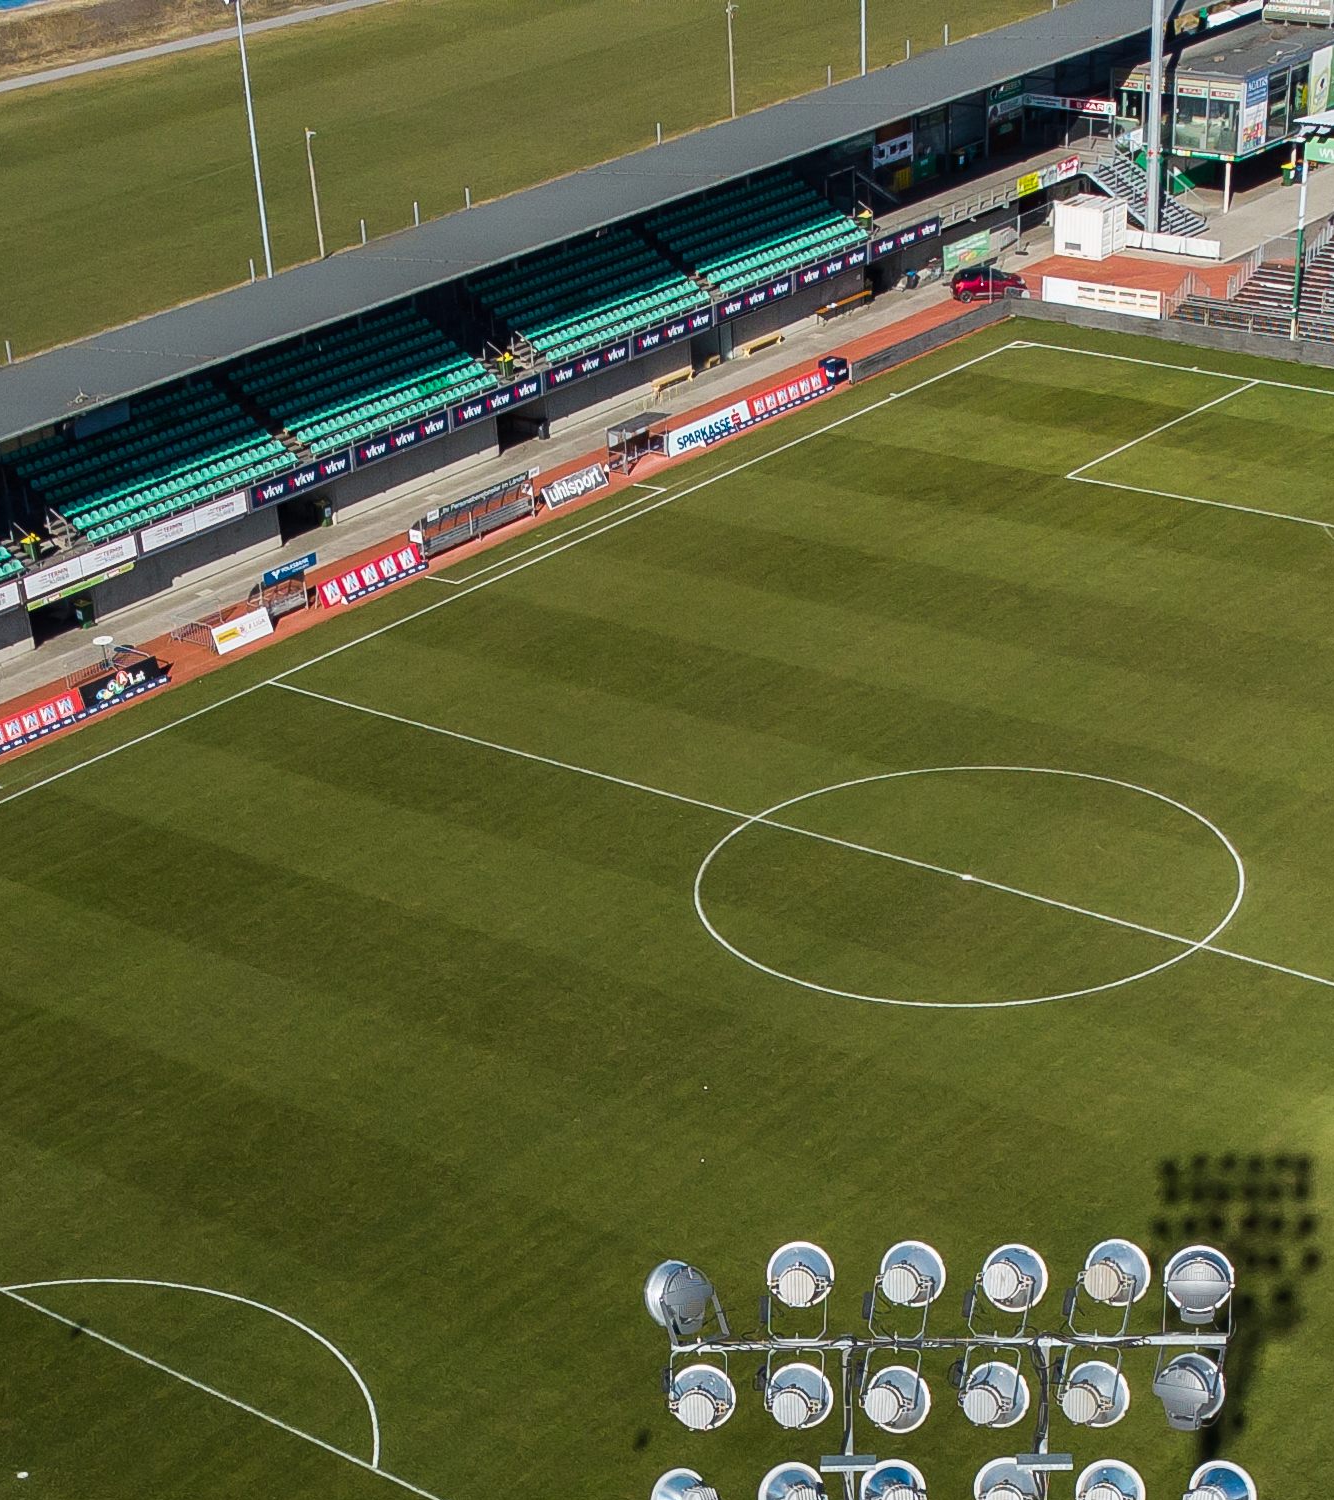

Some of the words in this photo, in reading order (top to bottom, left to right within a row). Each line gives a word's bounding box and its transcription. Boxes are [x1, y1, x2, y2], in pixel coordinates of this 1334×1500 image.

[581, 357, 599, 372] vkw
[463, 404, 482, 420] vkw
[491, 393, 509, 408] vkw
[519, 382, 537, 397] vkw
[366, 442, 386, 459] vkw
[396, 431, 415, 447] vkw
[425, 420, 444, 435] vkw
[677, 416, 731, 450] SPARKASSE
[263, 484, 284, 500] vkw
[294, 470, 315, 487] vkw
[325, 459, 346, 474] vkw
[548, 466, 603, 503] uhlsport
